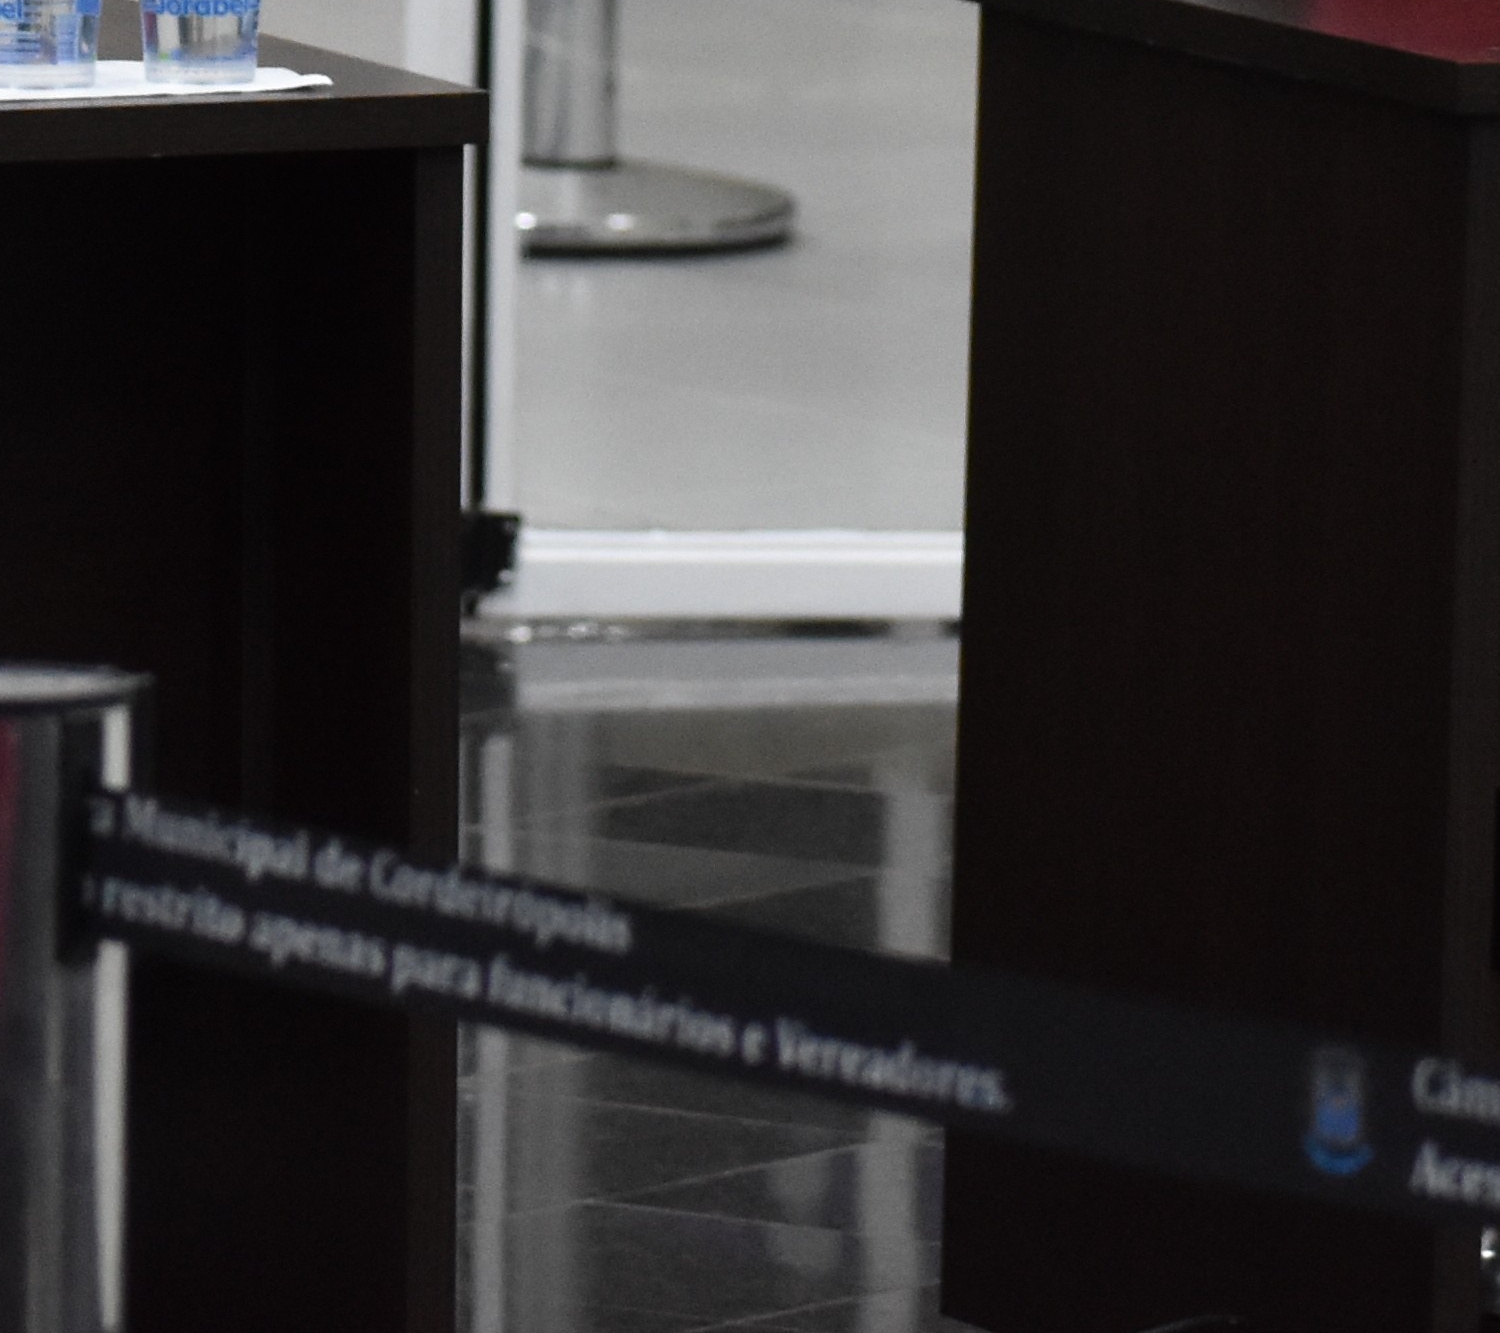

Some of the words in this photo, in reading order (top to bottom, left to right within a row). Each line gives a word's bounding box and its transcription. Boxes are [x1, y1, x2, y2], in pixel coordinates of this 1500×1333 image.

[123, 795, 309, 880] Municipal
[314, 838, 362, 893] de
[369, 847, 633, 953] Cordeirópolis
[103, 875, 246, 944] restrito
[250, 911, 387, 977] apenas
[391, 943, 482, 1000] para
[487, 953, 734, 1057] funcionários
[740, 1021, 765, 1066] e
